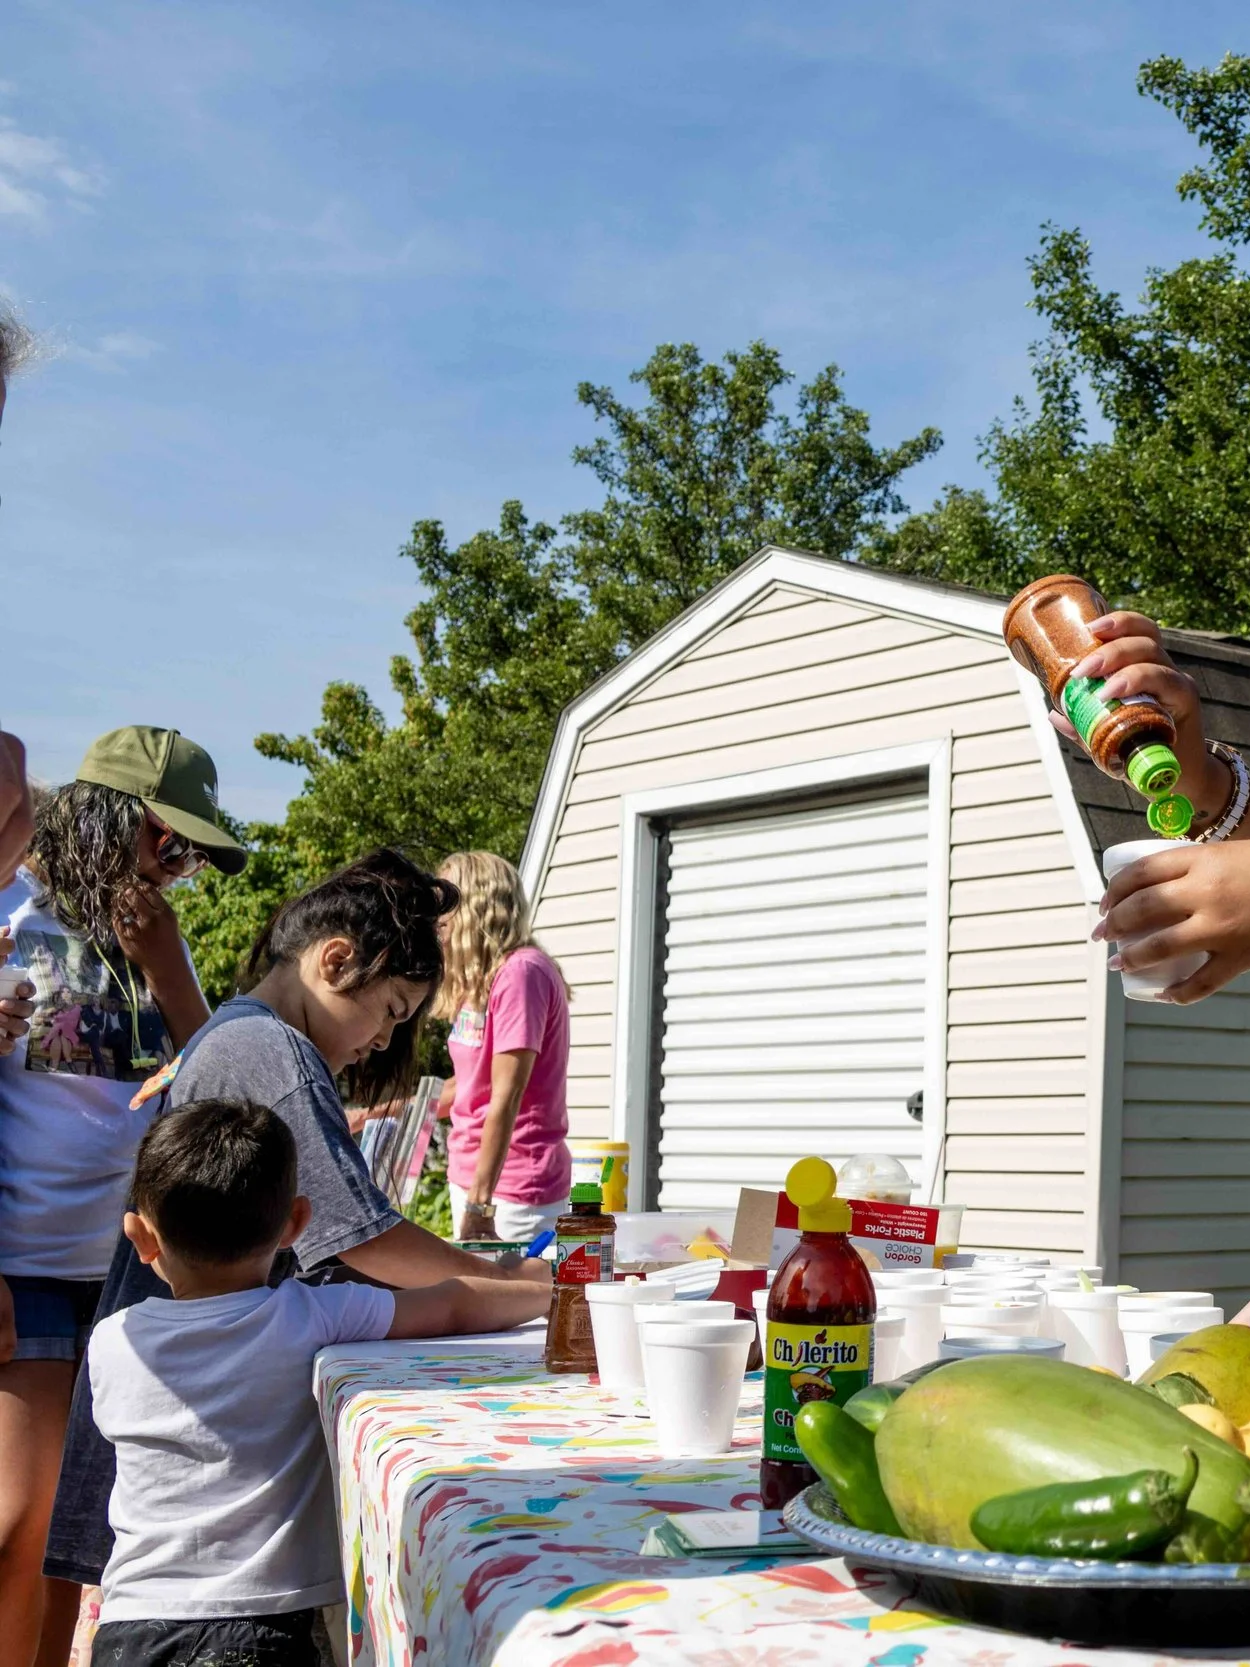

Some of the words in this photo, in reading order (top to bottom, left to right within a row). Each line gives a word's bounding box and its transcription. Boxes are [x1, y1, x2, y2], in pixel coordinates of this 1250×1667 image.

[864, 1224, 892, 1236] Forks
[893, 1228, 926, 1240] Plastic
[884, 1252, 922, 1264] Gordon
[771, 1443, 781, 1452] Net
